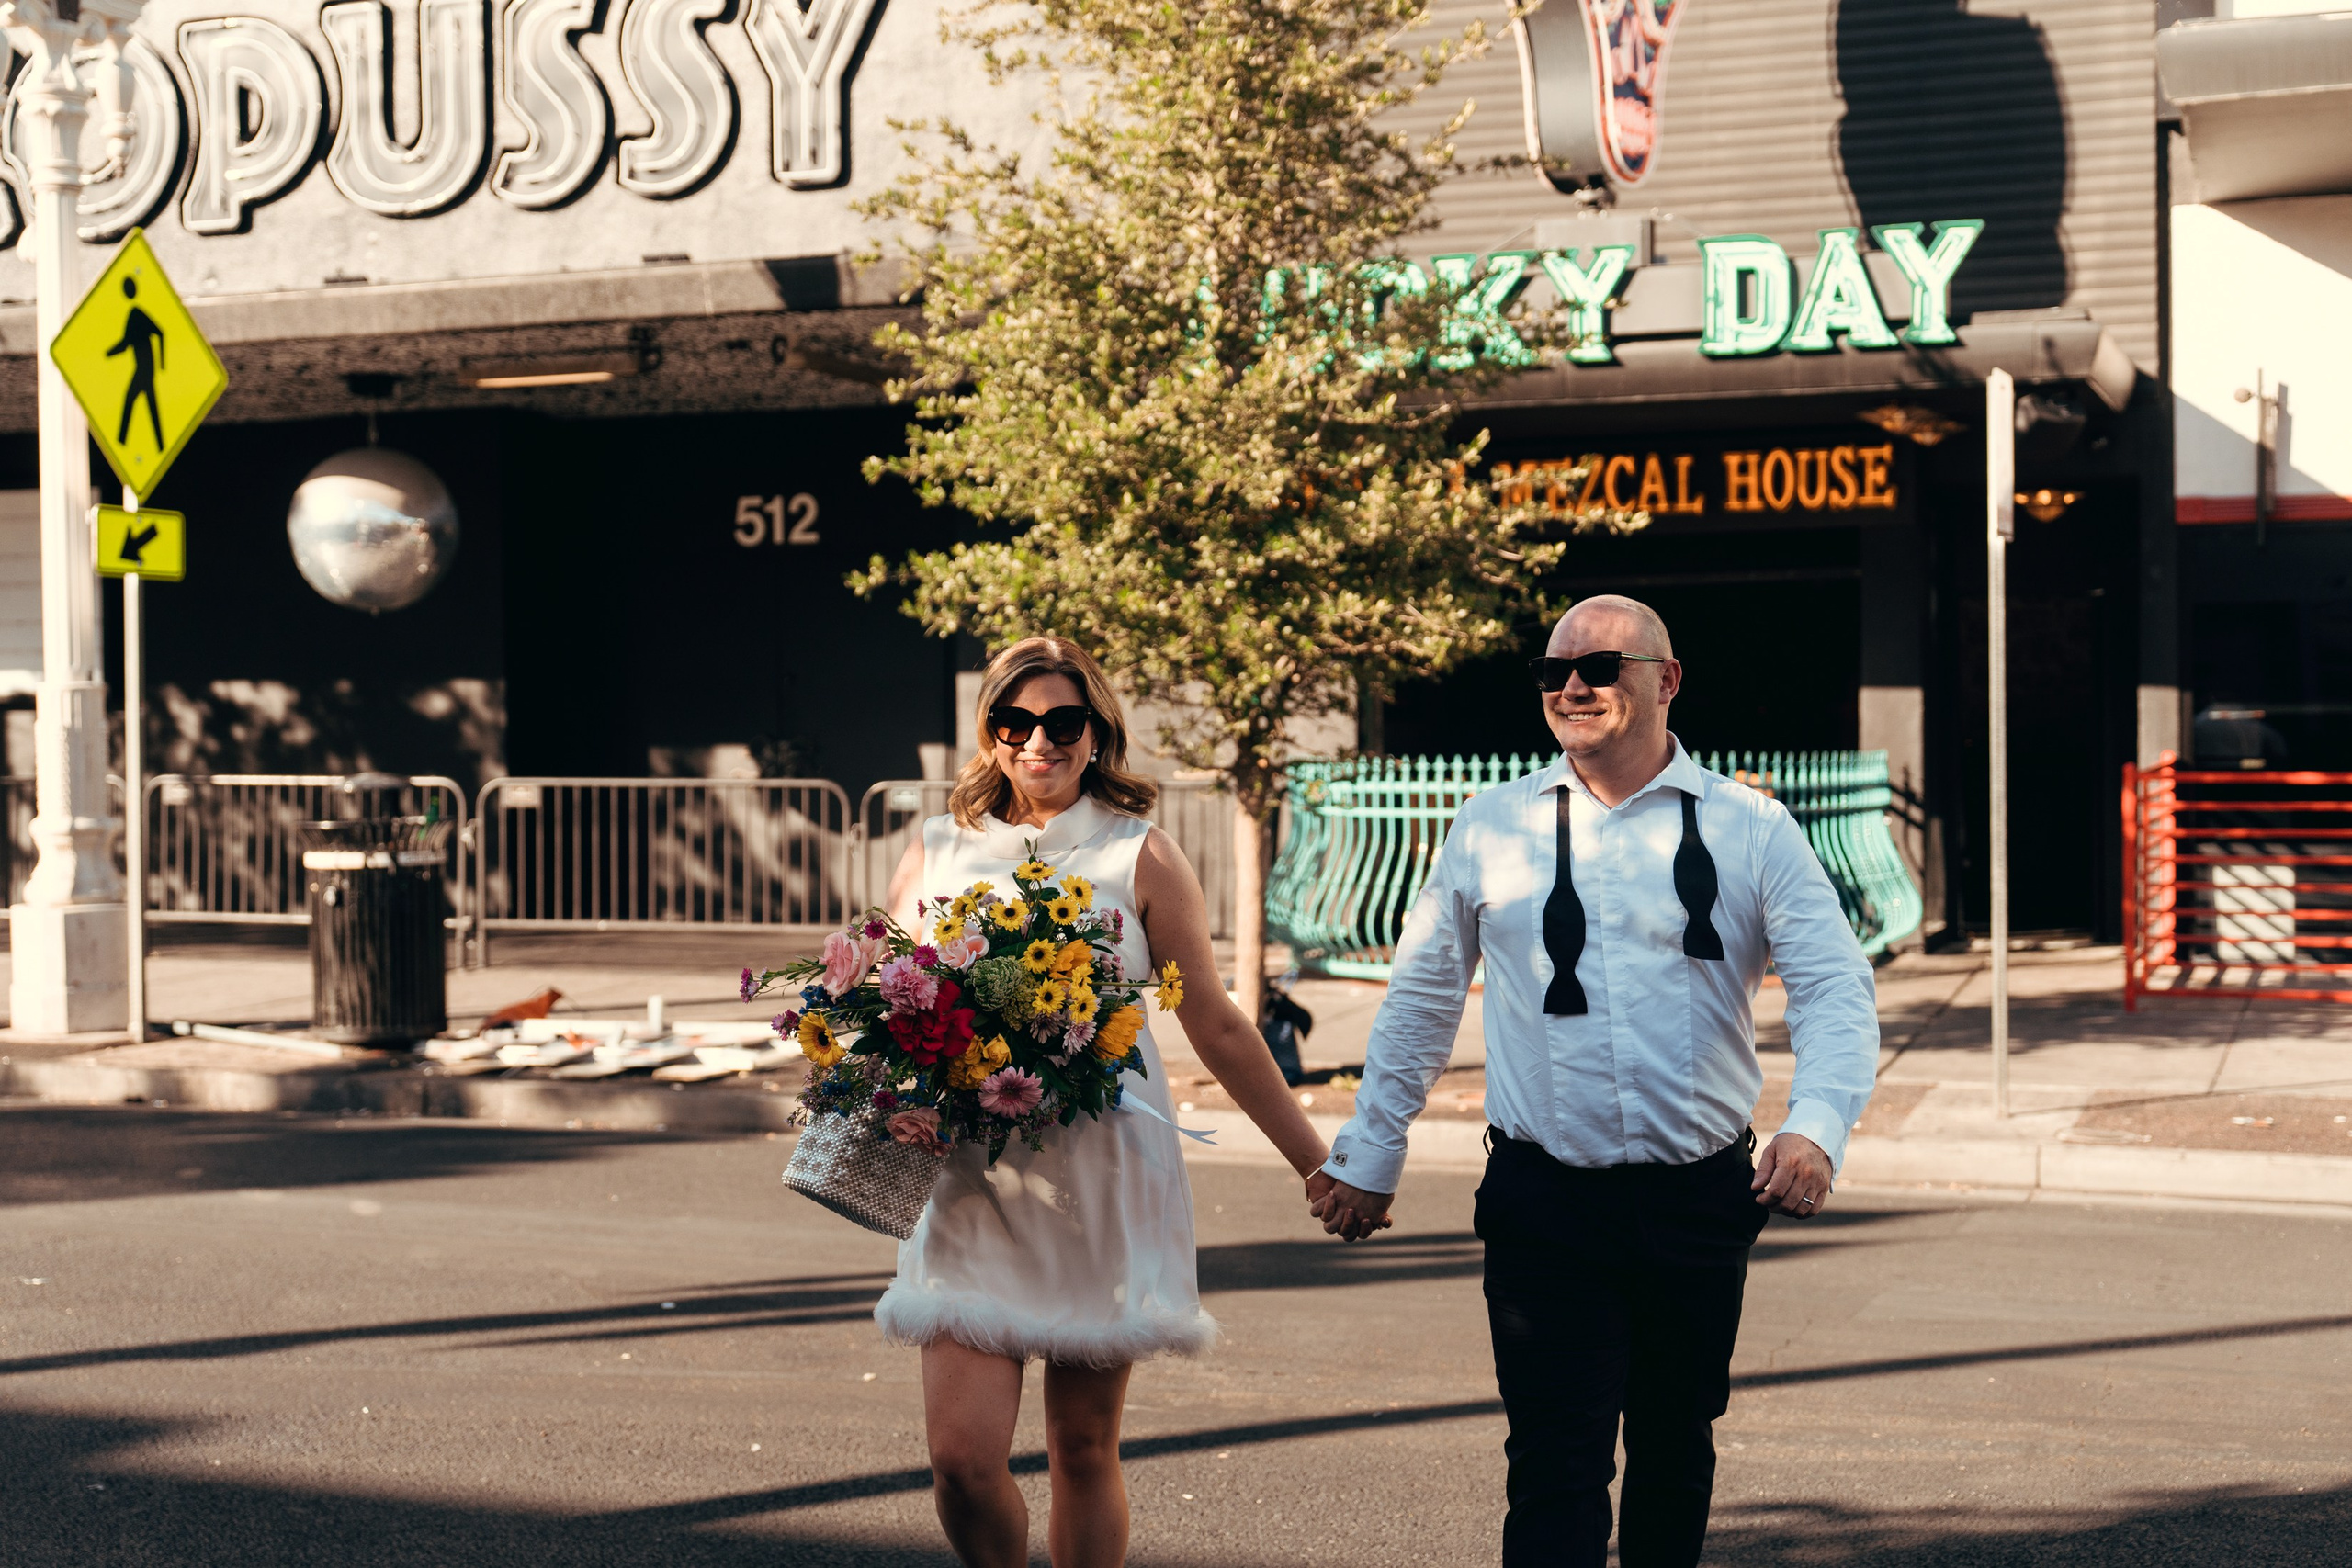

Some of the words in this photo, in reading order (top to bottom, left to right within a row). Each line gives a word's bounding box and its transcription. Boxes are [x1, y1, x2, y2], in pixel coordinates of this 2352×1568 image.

[0, 0, 873, 242] OPUSSY
[1697, 219, 1984, 355] DAY
[734, 492, 820, 547] 512
[1723, 443, 1897, 511] HOUSE
